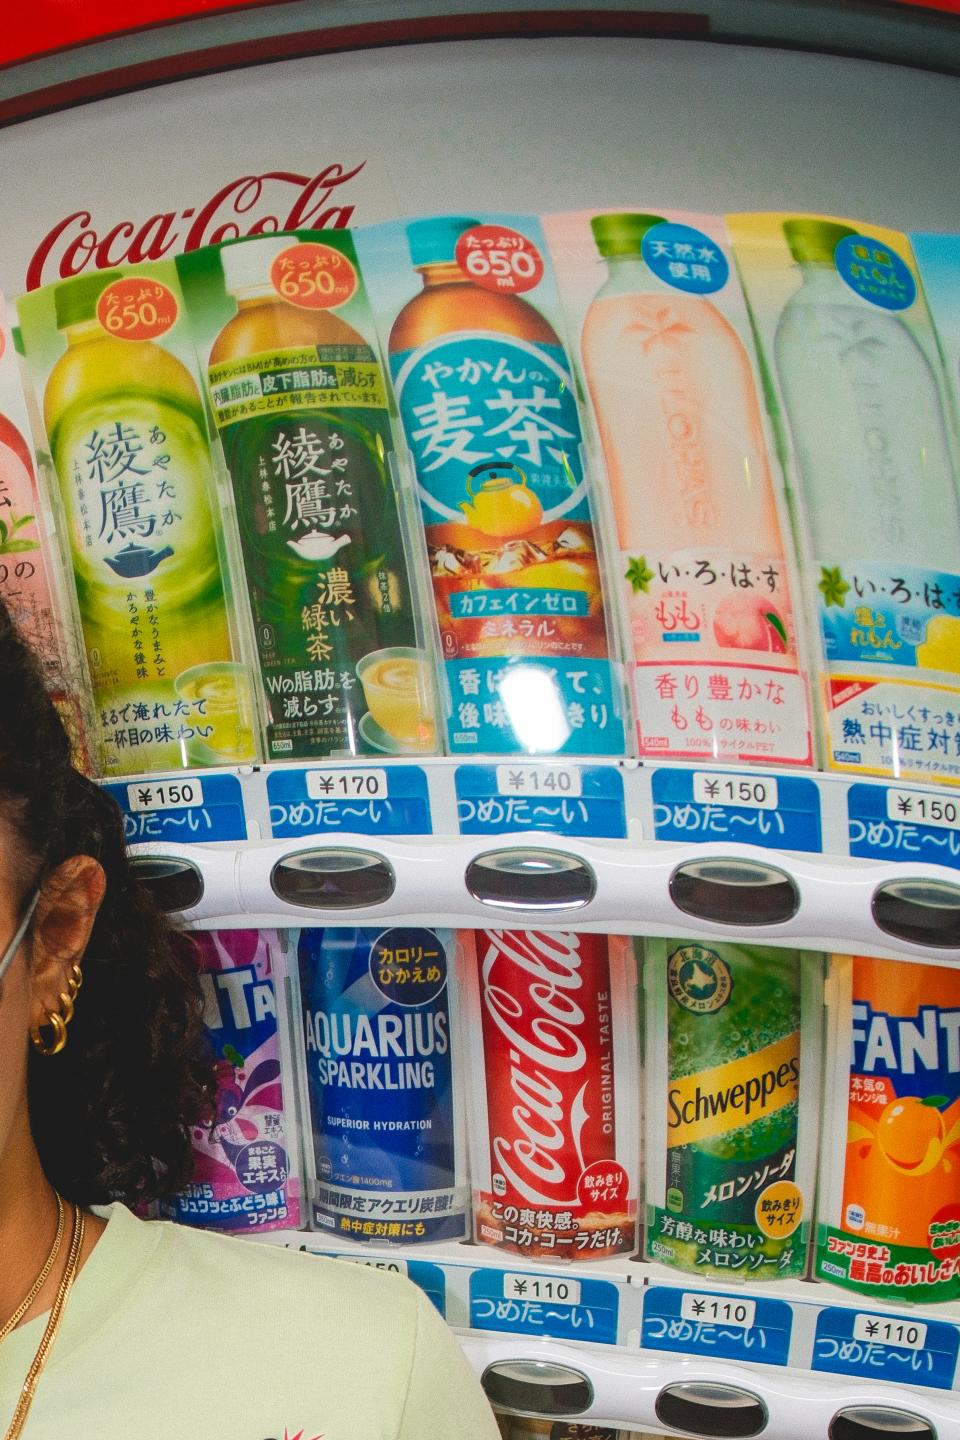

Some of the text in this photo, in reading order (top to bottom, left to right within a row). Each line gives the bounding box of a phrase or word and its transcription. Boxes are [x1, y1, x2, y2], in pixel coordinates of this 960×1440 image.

[25, 160, 368, 293] Coca-Cola
[466, 235, 524, 250] たっぷり
[648, 240, 719, 263] 天然水
[279, 253, 342, 270] たっぷり
[466, 250, 536, 277] 650
[668, 261, 712, 283] 使用
[105, 287, 164, 306] たっぷり
[411, 385, 576, 473] 麦茶
[86, 421, 157, 544] 綾鷹
[147, 424, 182, 527] あやたか
[271, 427, 336, 530] 綾鷹
[328, 432, 358, 520] あやたか
[460, 592, 578, 614] カフェインゼロ
[655, 600, 701, 631] もも
[655, 672, 785, 705] 香り豊かな
[283, 694, 339, 718] 減らす
[671, 704, 781, 734] ももの味わい
[319, 776, 379, 794] ¥170
[508, 771, 571, 791] ¥140
[704, 778, 766, 803] ¥150
[138, 784, 194, 806] ¥150
[897, 795, 957, 823] ¥150
[378, 947, 438, 964] カロリー
[378, 968, 441, 985] ひかえめ
[305, 1009, 448, 1058] AQUARIUS
[318, 1058, 435, 1090] SPARKLING
[482, 929, 587, 1208] Coca-Cola
[597, 990, 613, 1136] ORIGINAL TASTE
[667, 1057, 800, 1128] Schweppes
[851, 1077, 886, 1092] 本気の
[327, 1115, 432, 1131] SUPERIOR HYDRATION
[248, 1155, 277, 1170] 果実
[584, 1171, 623, 1188] 飲みきり
[700, 1149, 796, 1209] メロンソーダ
[590, 1187, 619, 1202] サイズ
[761, 1197, 800, 1213] 飲みきり
[248, 1206, 288, 1225] ファンタ
[340, 1217, 426, 1237] 熱中症対策にも
[491, 1201, 579, 1231] この爽快感。
[766, 1213, 796, 1226] サイズ
[660, 1215, 764, 1248] 芳醇な味わい
[697, 1249, 794, 1270] メロンソーダ
[827, 1236, 891, 1262] ファンタ史上
[513, 1278, 569, 1300] ¥110
[691, 1299, 747, 1322] ¥110
[865, 1319, 919, 1344] ¥110
